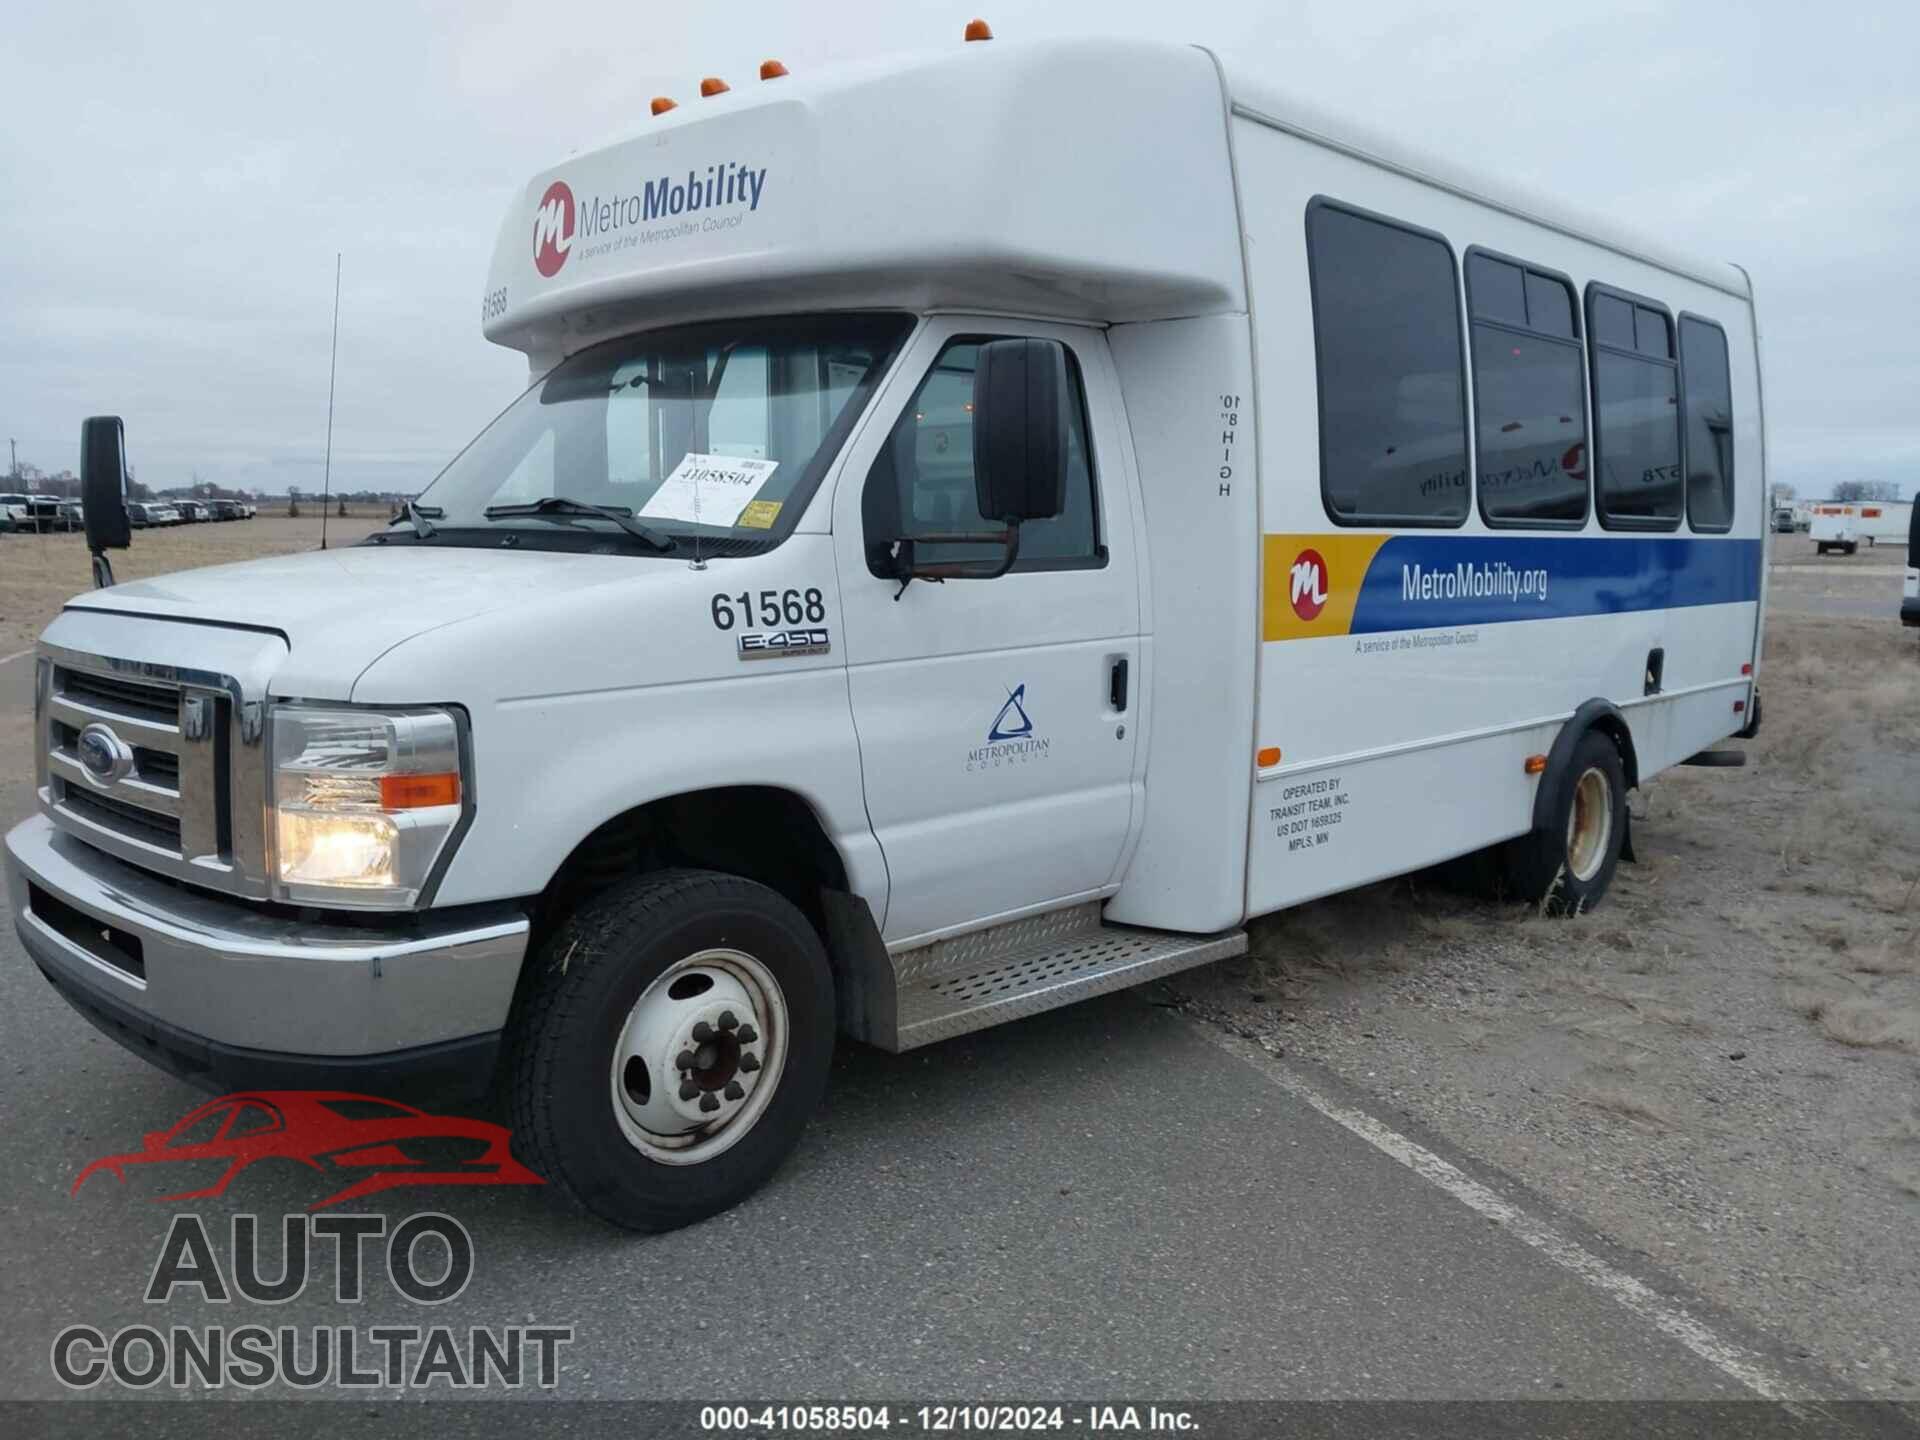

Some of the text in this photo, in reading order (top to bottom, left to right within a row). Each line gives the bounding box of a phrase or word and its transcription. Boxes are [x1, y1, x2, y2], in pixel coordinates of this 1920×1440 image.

[579, 162, 766, 238] MetroMobility
[640, 222, 699, 243] Metropolitan
[702, 213, 742, 233] Council
[681, 468, 755, 486] 41058504
[1402, 562, 1549, 603] MetroMobility.org
[711, 588, 825, 630] 61568
[1355, 640, 1361, 653] A
[968, 738, 1050, 761] METROPOLITAN
[1283, 778, 1341, 800] OPERATED BY
[1270, 803, 1306, 820] TRANSIT
[1277, 824, 1289, 836] US
[1290, 820, 1308, 834] DOT
[1316, 832, 1329, 845] MN
